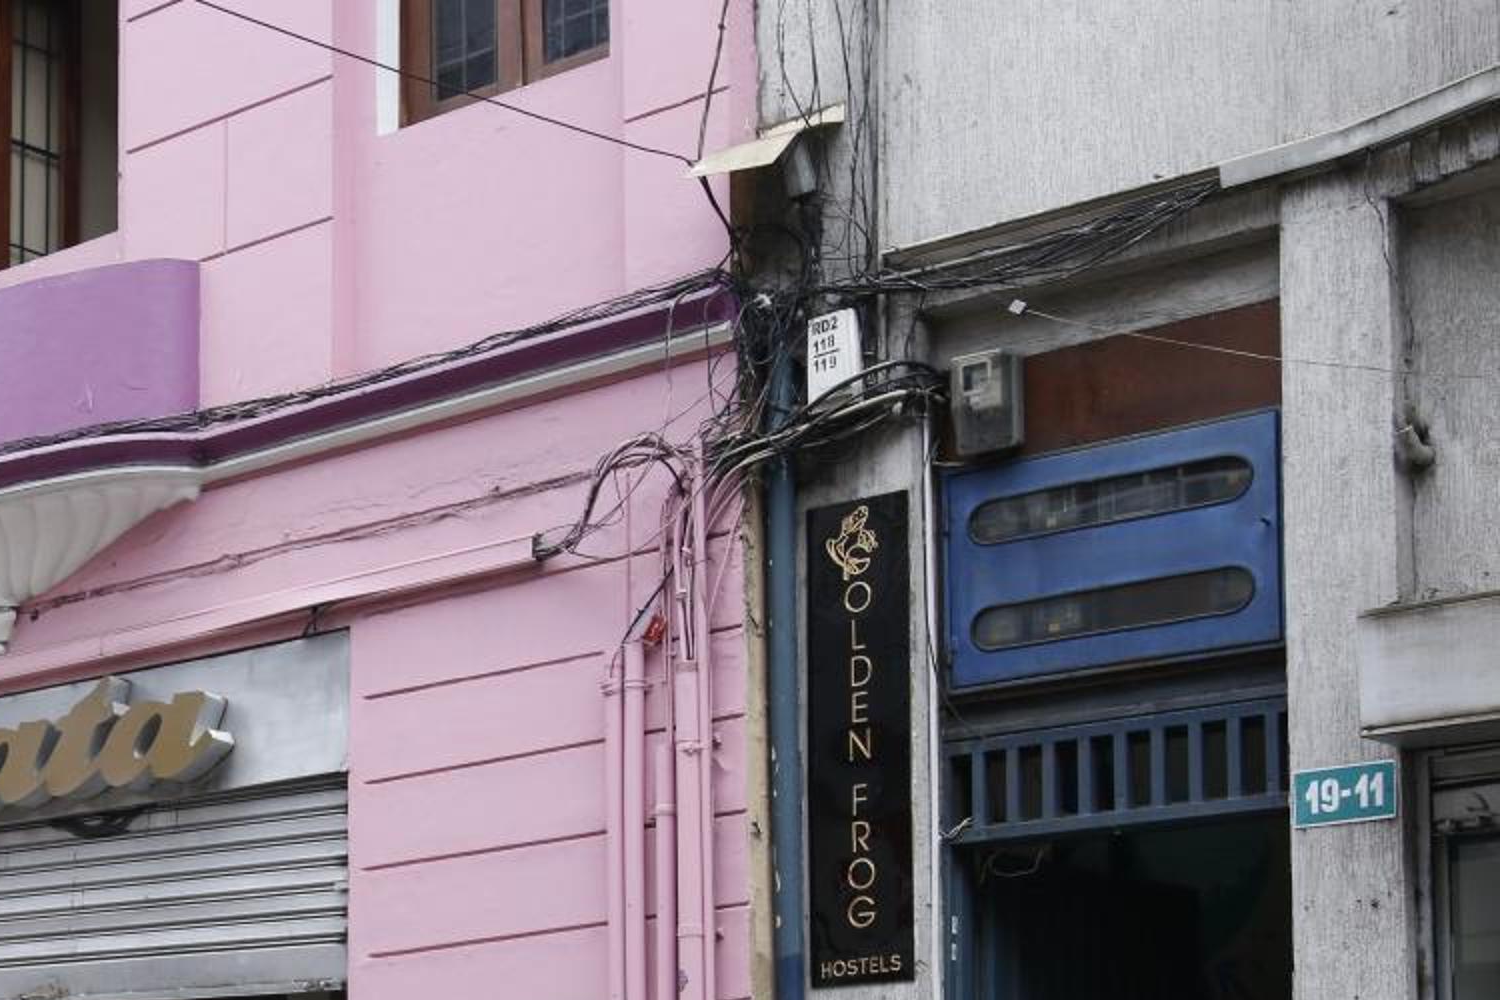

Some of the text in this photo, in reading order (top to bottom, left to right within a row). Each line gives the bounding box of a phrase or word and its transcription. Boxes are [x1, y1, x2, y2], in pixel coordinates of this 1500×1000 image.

[1305, 771, 1384, 816] 19-11
[847, 783, 877, 929] FROG
[820, 953, 902, 979] HOSTELS
